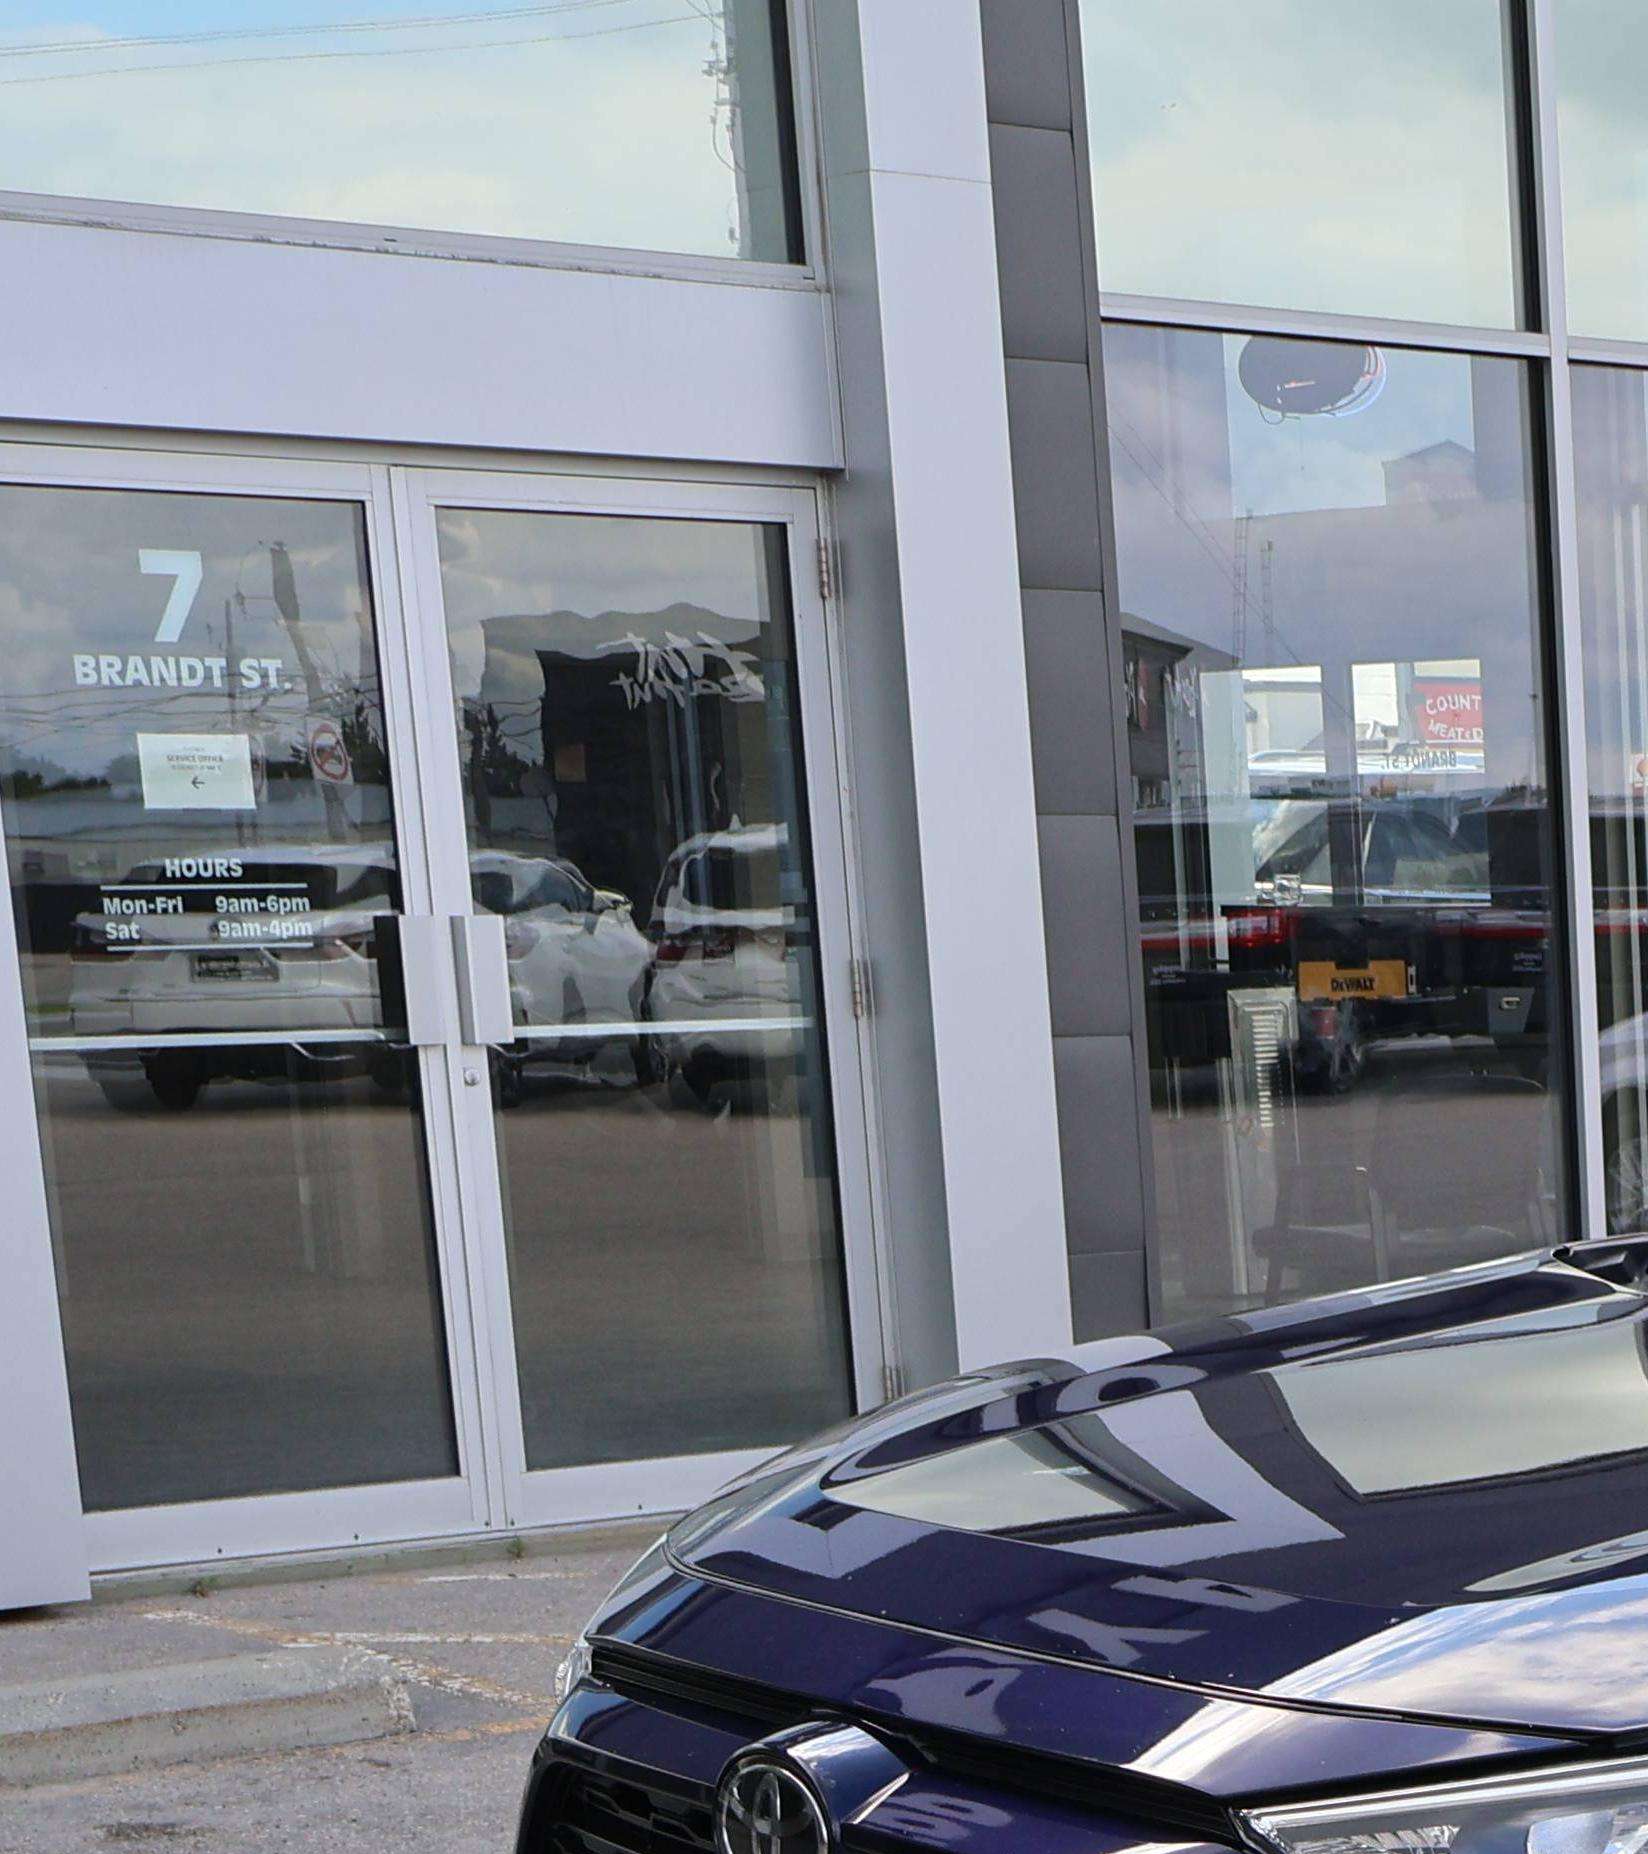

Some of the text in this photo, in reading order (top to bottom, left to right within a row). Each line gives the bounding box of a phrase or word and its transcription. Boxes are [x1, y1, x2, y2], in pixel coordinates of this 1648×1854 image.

[138, 548, 203, 643] 7
[73, 654, 293, 690] BRANDT ST.
[164, 857, 244, 879] HOURS
[102, 894, 311, 916] Mon-Fri 9am-6pm
[105, 920, 313, 940] Sat 9am-4pm
